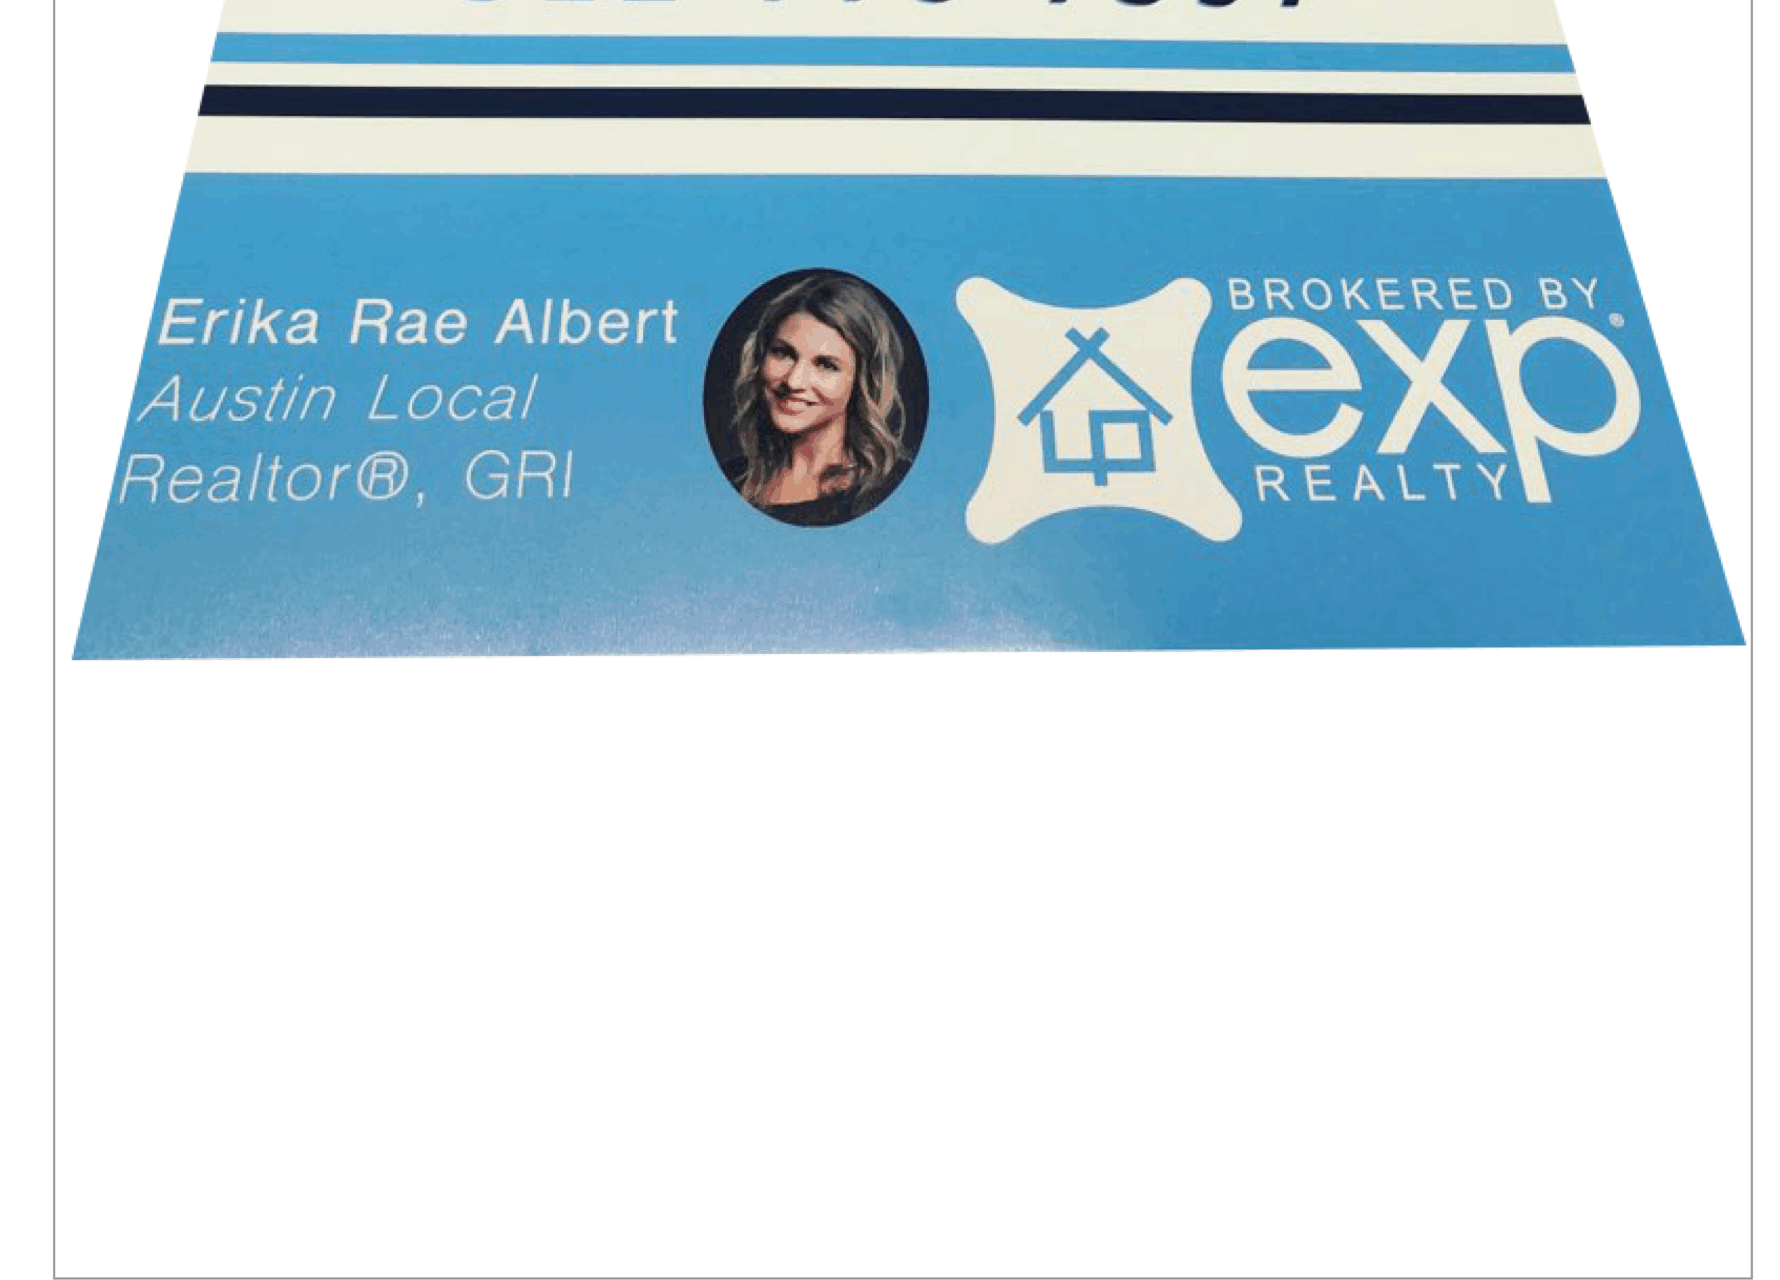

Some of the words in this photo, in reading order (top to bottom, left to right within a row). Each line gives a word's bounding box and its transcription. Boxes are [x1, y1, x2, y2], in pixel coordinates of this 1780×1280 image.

[1228, 277, 1513, 310] BROKERED
[1539, 277, 1599, 310] BY
[156, 298, 320, 346] Erika
[349, 300, 468, 346] Rae
[494, 298, 679, 346] Albert
[136, 374, 336, 423] Austin
[368, 373, 539, 422] Local
[1221, 317, 1640, 503] exp
[464, 450, 574, 502] GRI
[1254, 464, 1508, 502] REALTY
